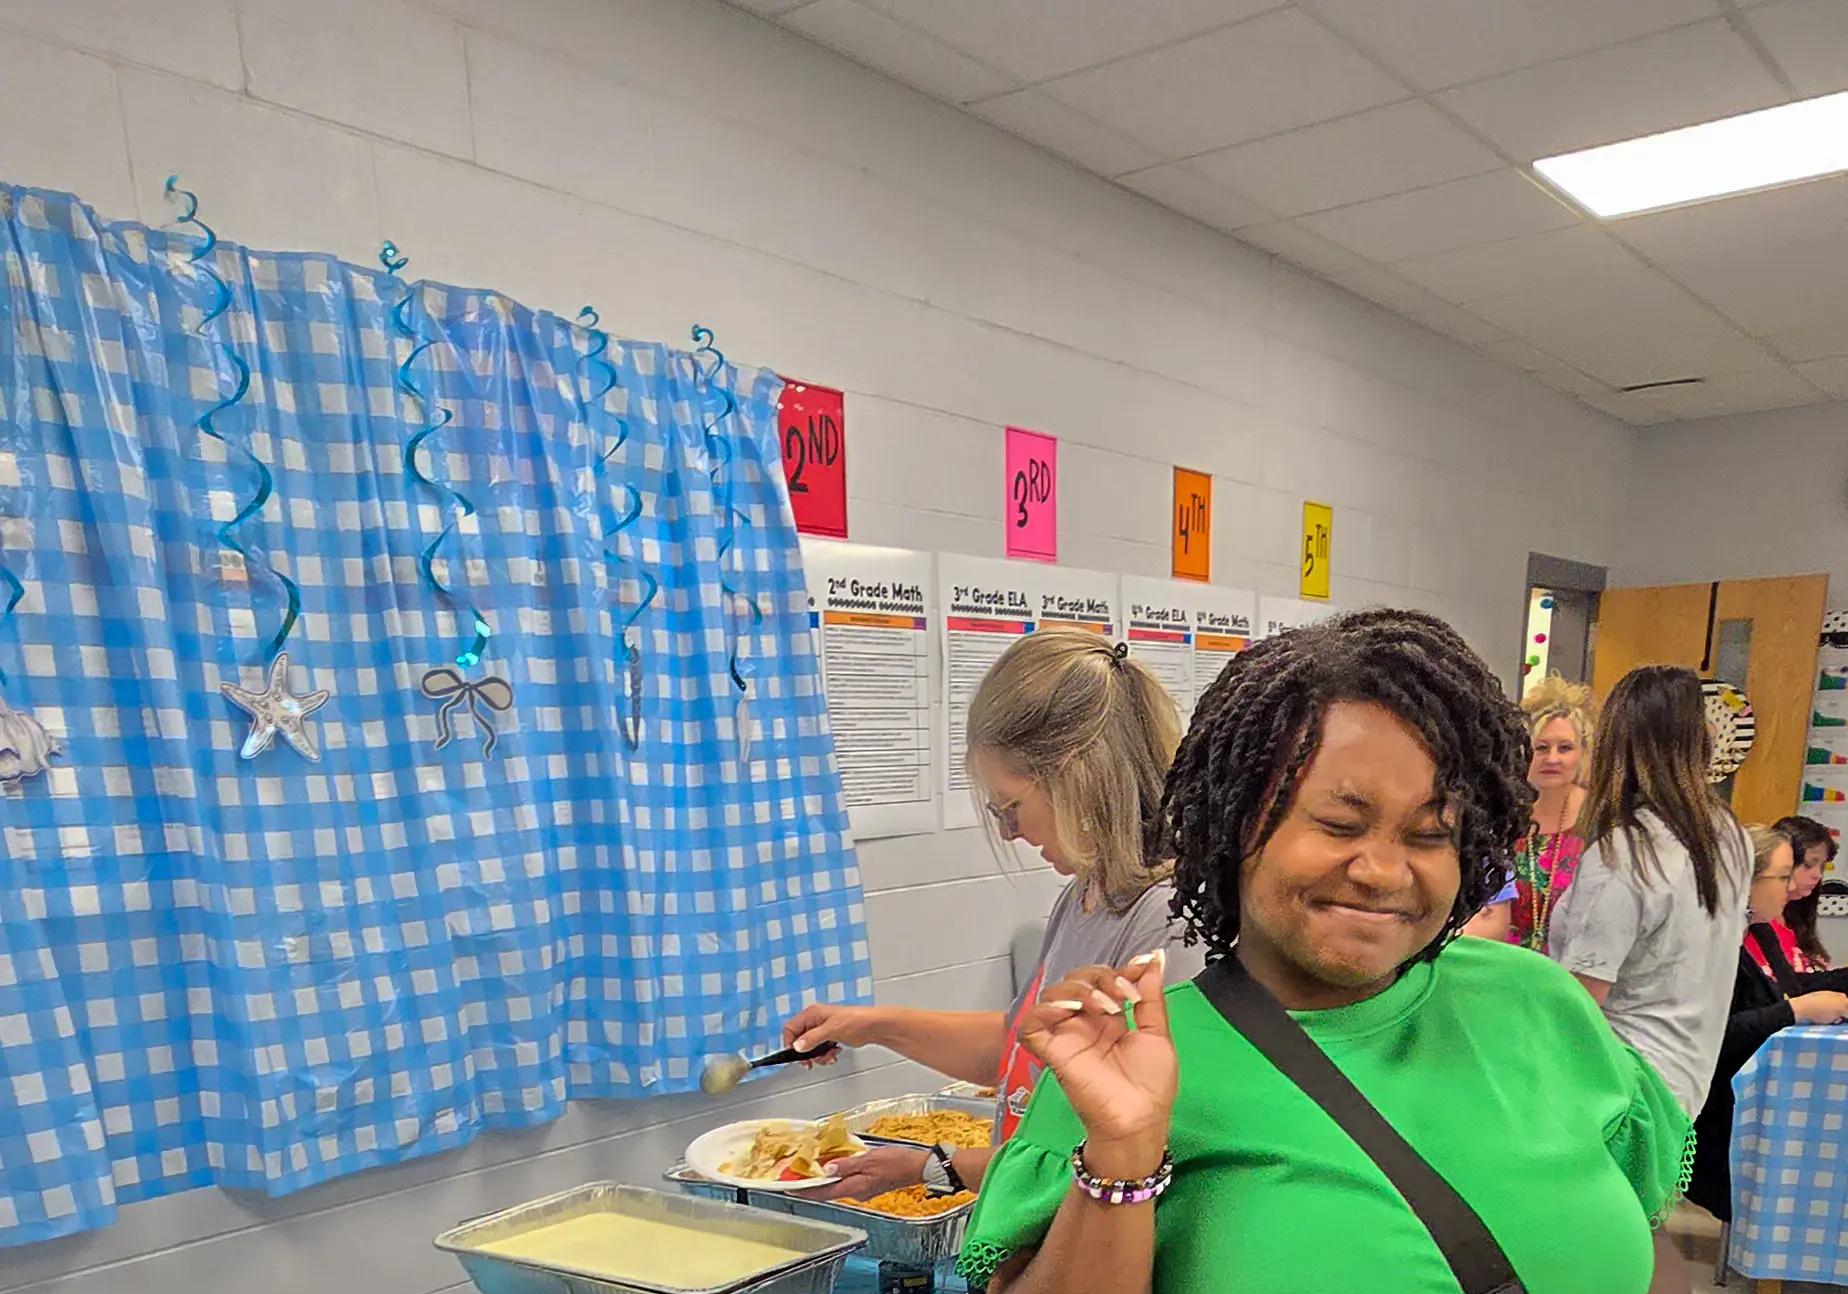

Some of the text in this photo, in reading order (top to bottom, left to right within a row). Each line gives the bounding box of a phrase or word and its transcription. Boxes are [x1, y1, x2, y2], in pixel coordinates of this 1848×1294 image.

[786, 415, 839, 493] 2ND
[1014, 458, 1050, 527] 3RD
[1179, 493, 1206, 554] 4TH
[1304, 524, 1328, 577] 5TH
[827, 577, 924, 602] 2nd Grade Math
[953, 586, 1028, 608] 3rd Grade ELA
[1058, 596, 1085, 613] Grade
[1087, 598, 1110, 614] Math
[1145, 606, 1170, 622] Grade
[1172, 608, 1187, 622] ELA
[1209, 613, 1230, 627] Grade
